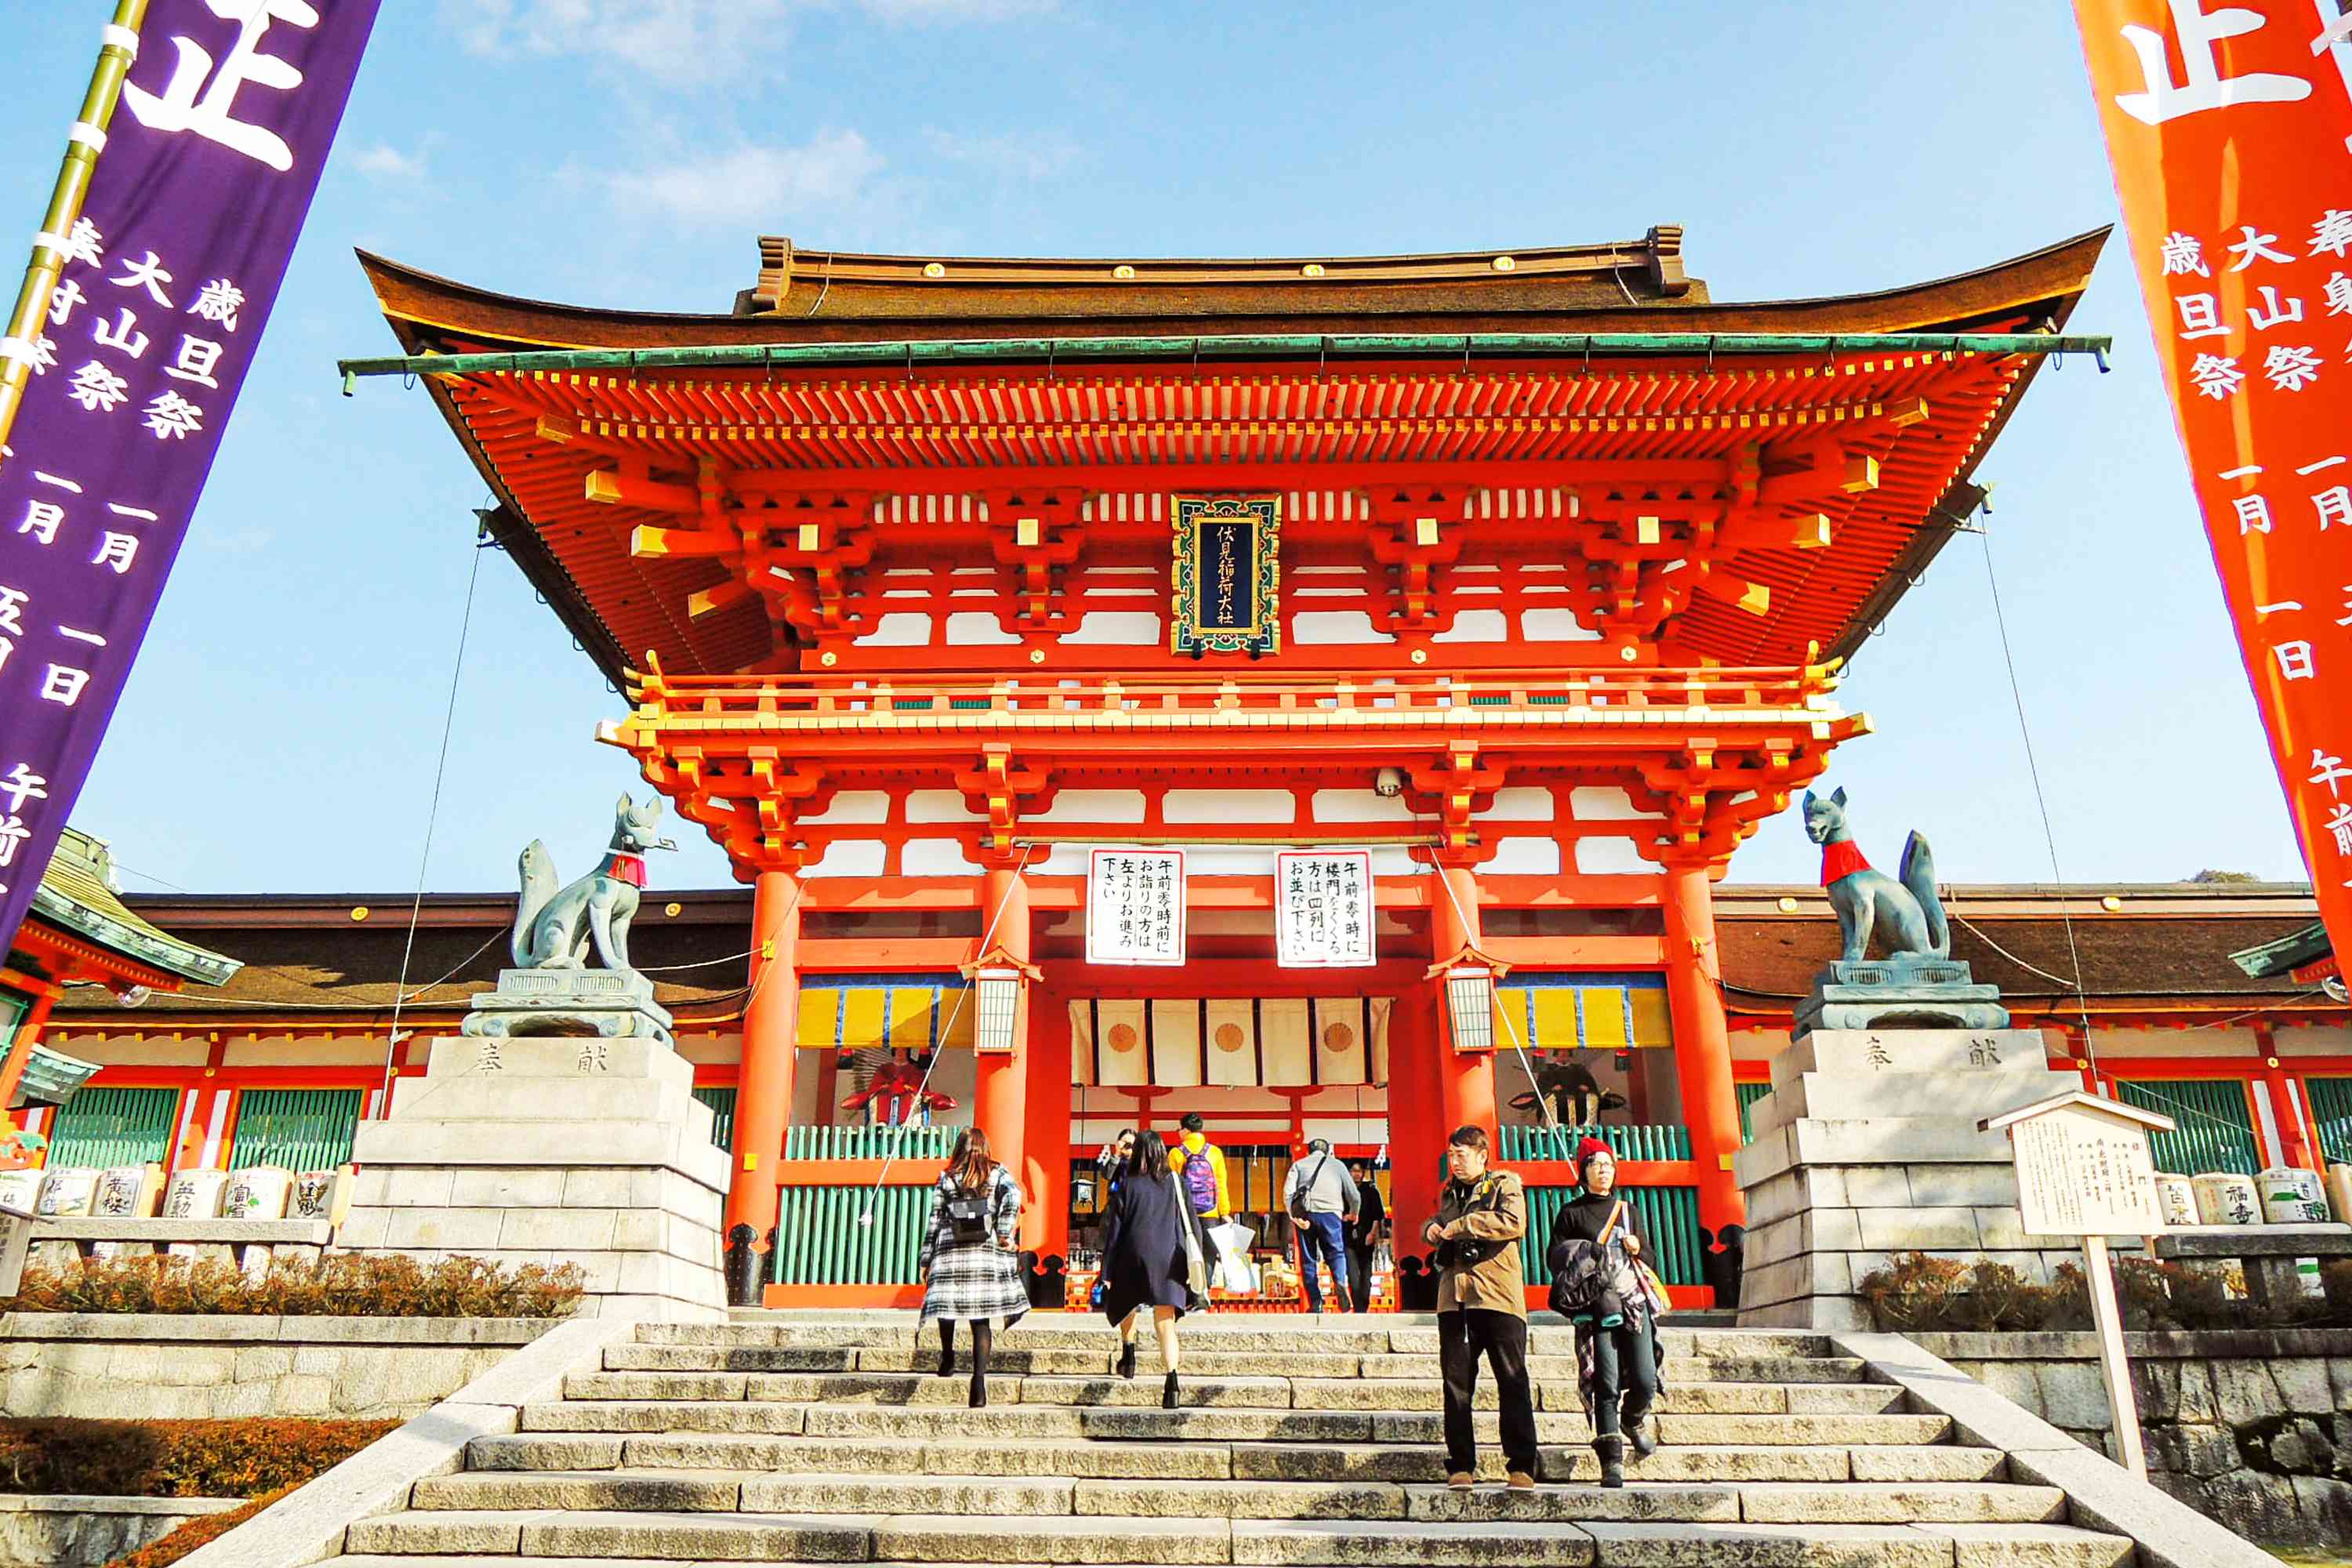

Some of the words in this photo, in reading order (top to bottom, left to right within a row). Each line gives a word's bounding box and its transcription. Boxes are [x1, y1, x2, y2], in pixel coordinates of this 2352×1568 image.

[68, 251, 174, 412] 大山祭
[142, 278, 245, 440] 歳旦祭
[2227, 226, 2323, 392] 大山祭
[2296, 456, 2352, 532] 一月
[2160, 231, 2246, 401] 歳旦祭
[2218, 464, 2273, 535] 一月
[2256, 599, 2318, 680] 一日
[18, 470, 82, 545] 一月
[93, 502, 158, 574] 一月
[1217, 526, 1236, 625] 伏見稲荷大社
[39, 625, 107, 706] 一日
[1102, 858, 1116, 898] 下さい
[1120, 858, 1134, 947] 左よりお進み
[1138, 859, 1152, 947] お詣りの方は
[1156, 859, 1173, 953] 午前零時前に
[1290, 862, 1305, 955] お並び下さい
[1308, 862, 1324, 942] 方は四列に
[1344, 862, 1360, 953] 午前零時に
